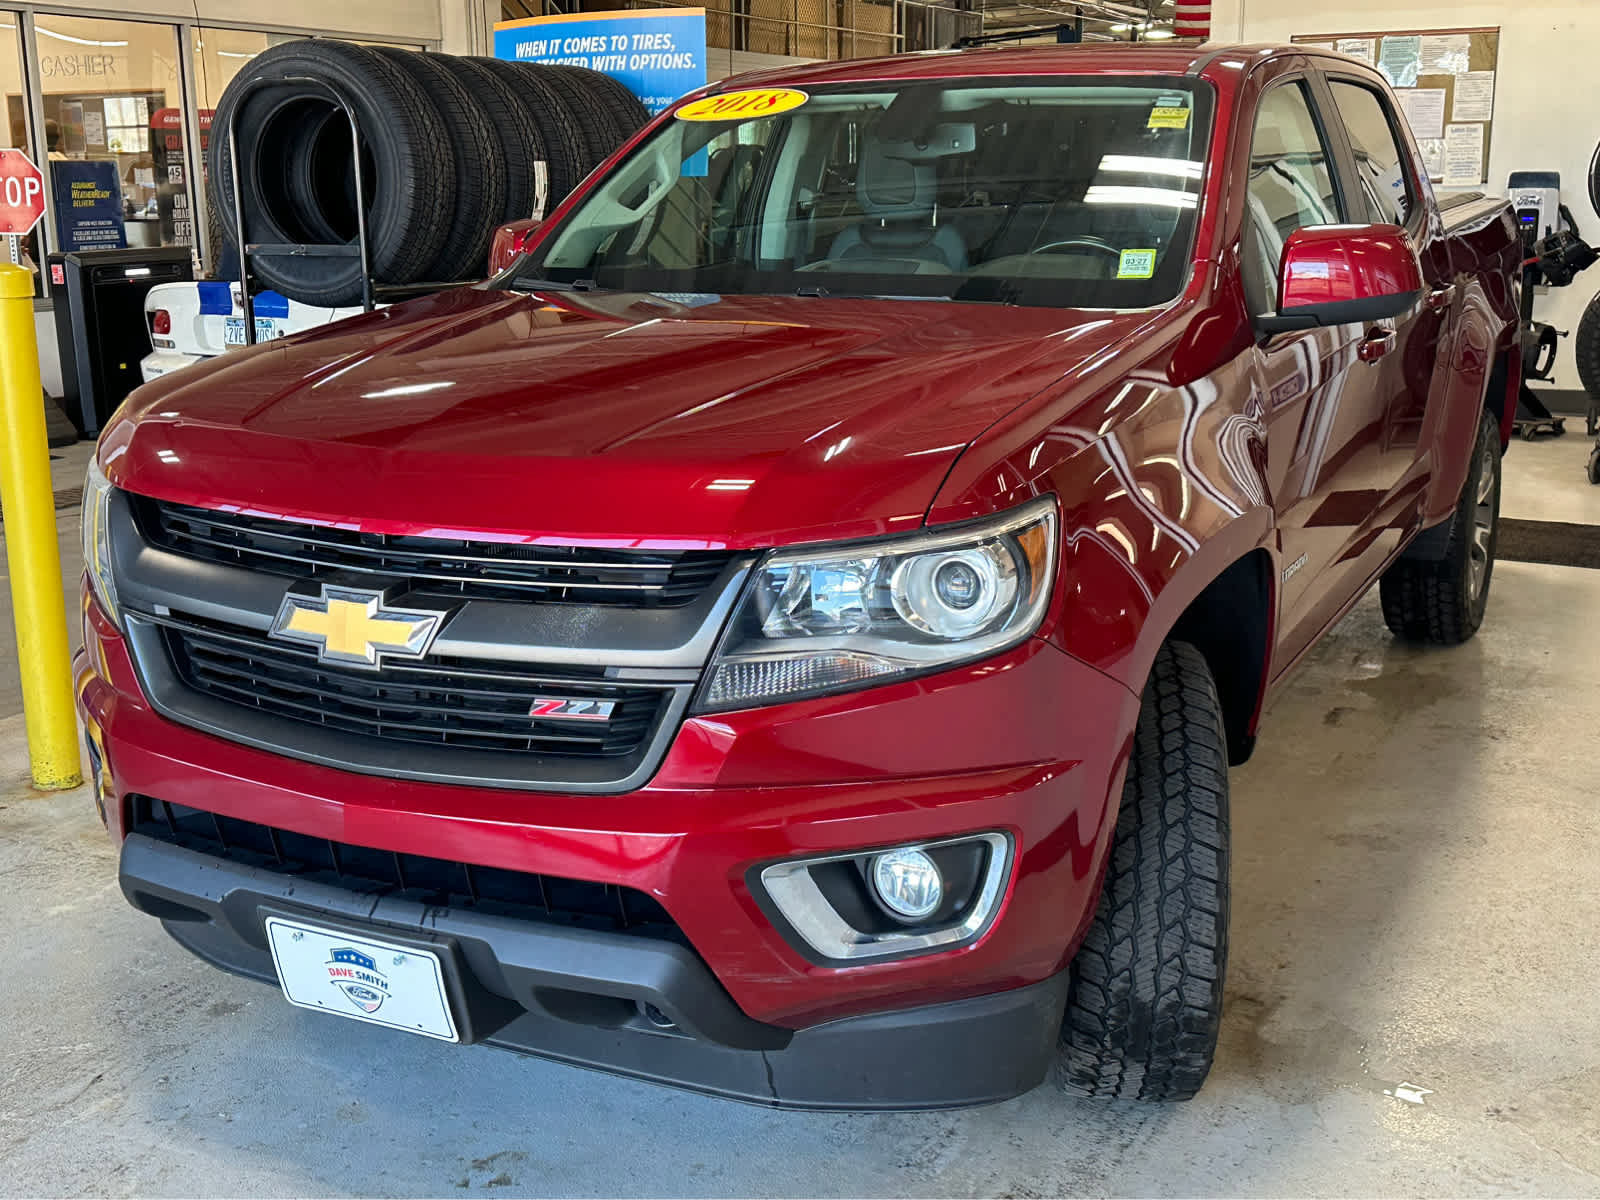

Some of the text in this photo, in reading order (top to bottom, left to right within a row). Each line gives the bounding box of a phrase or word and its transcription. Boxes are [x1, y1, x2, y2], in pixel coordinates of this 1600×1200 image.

[516, 33, 676, 58] WHEN IT COMES TO TIRES,
[41, 54, 116, 77] CASHIER
[592, 55, 627, 72] WITH
[630, 53, 696, 70] OPTIONS.
[688, 92, 789, 116] 2018
[169, 167, 181, 177] 45
[0, 176, 40, 208] OP
[529, 699, 615, 719] Z71
[328, 967, 388, 990] DAVE SMITH
